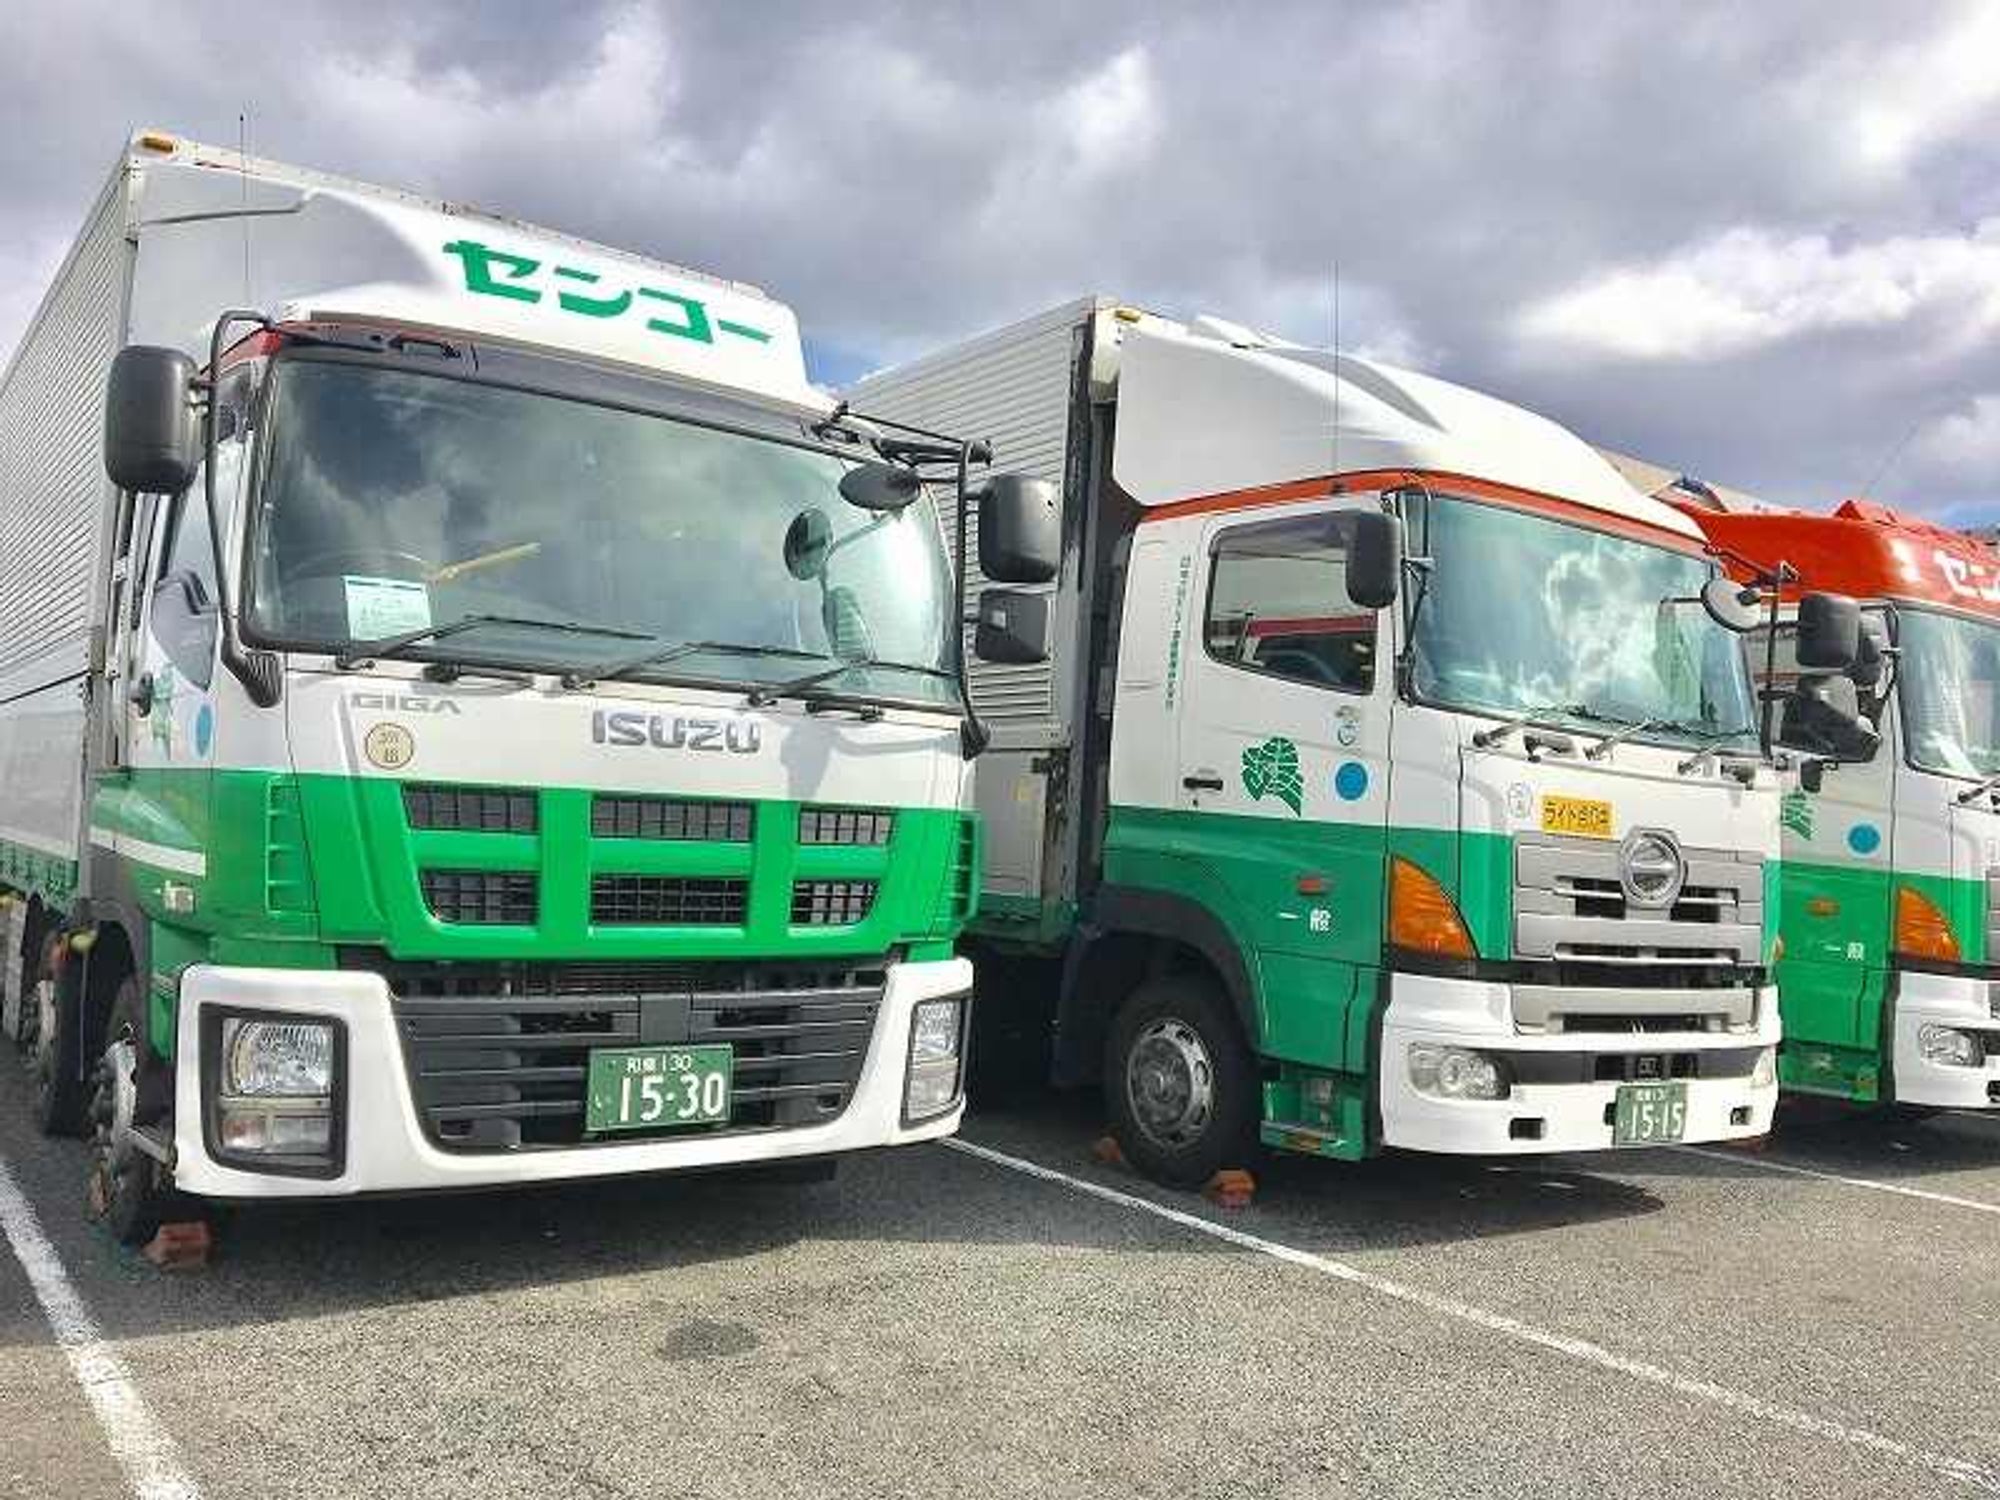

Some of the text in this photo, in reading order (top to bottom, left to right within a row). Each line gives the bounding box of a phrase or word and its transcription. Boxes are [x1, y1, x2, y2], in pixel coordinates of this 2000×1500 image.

[442, 239, 776, 345] センコー
[350, 692, 461, 715] GIGA
[593, 711, 761, 754] ISUZU
[662, 1054, 692, 1071] 130
